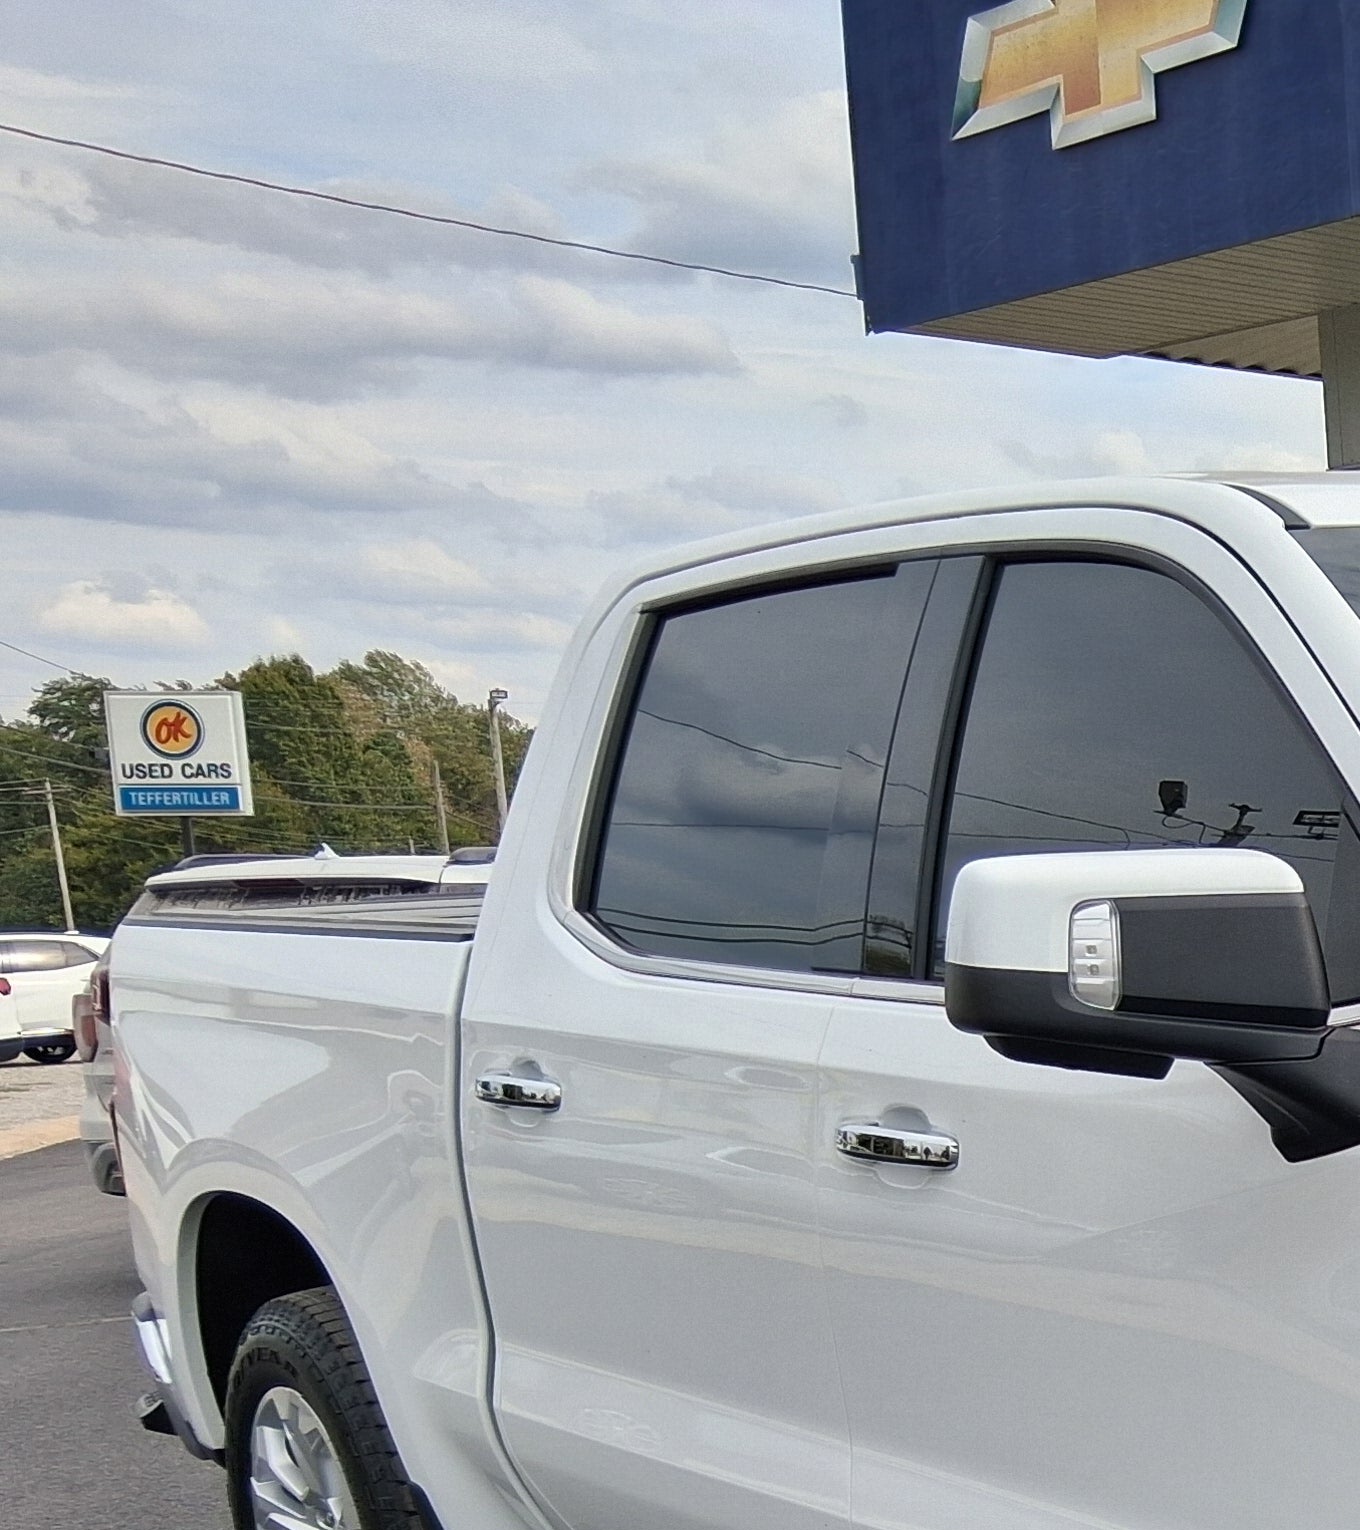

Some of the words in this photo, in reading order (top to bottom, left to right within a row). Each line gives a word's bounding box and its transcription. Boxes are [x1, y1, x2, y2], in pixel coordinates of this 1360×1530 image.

[155, 711, 192, 744] OK
[121, 763, 173, 779] USED
[180, 763, 232, 779] CARS
[129, 791, 230, 806] TEFFERTILLER
